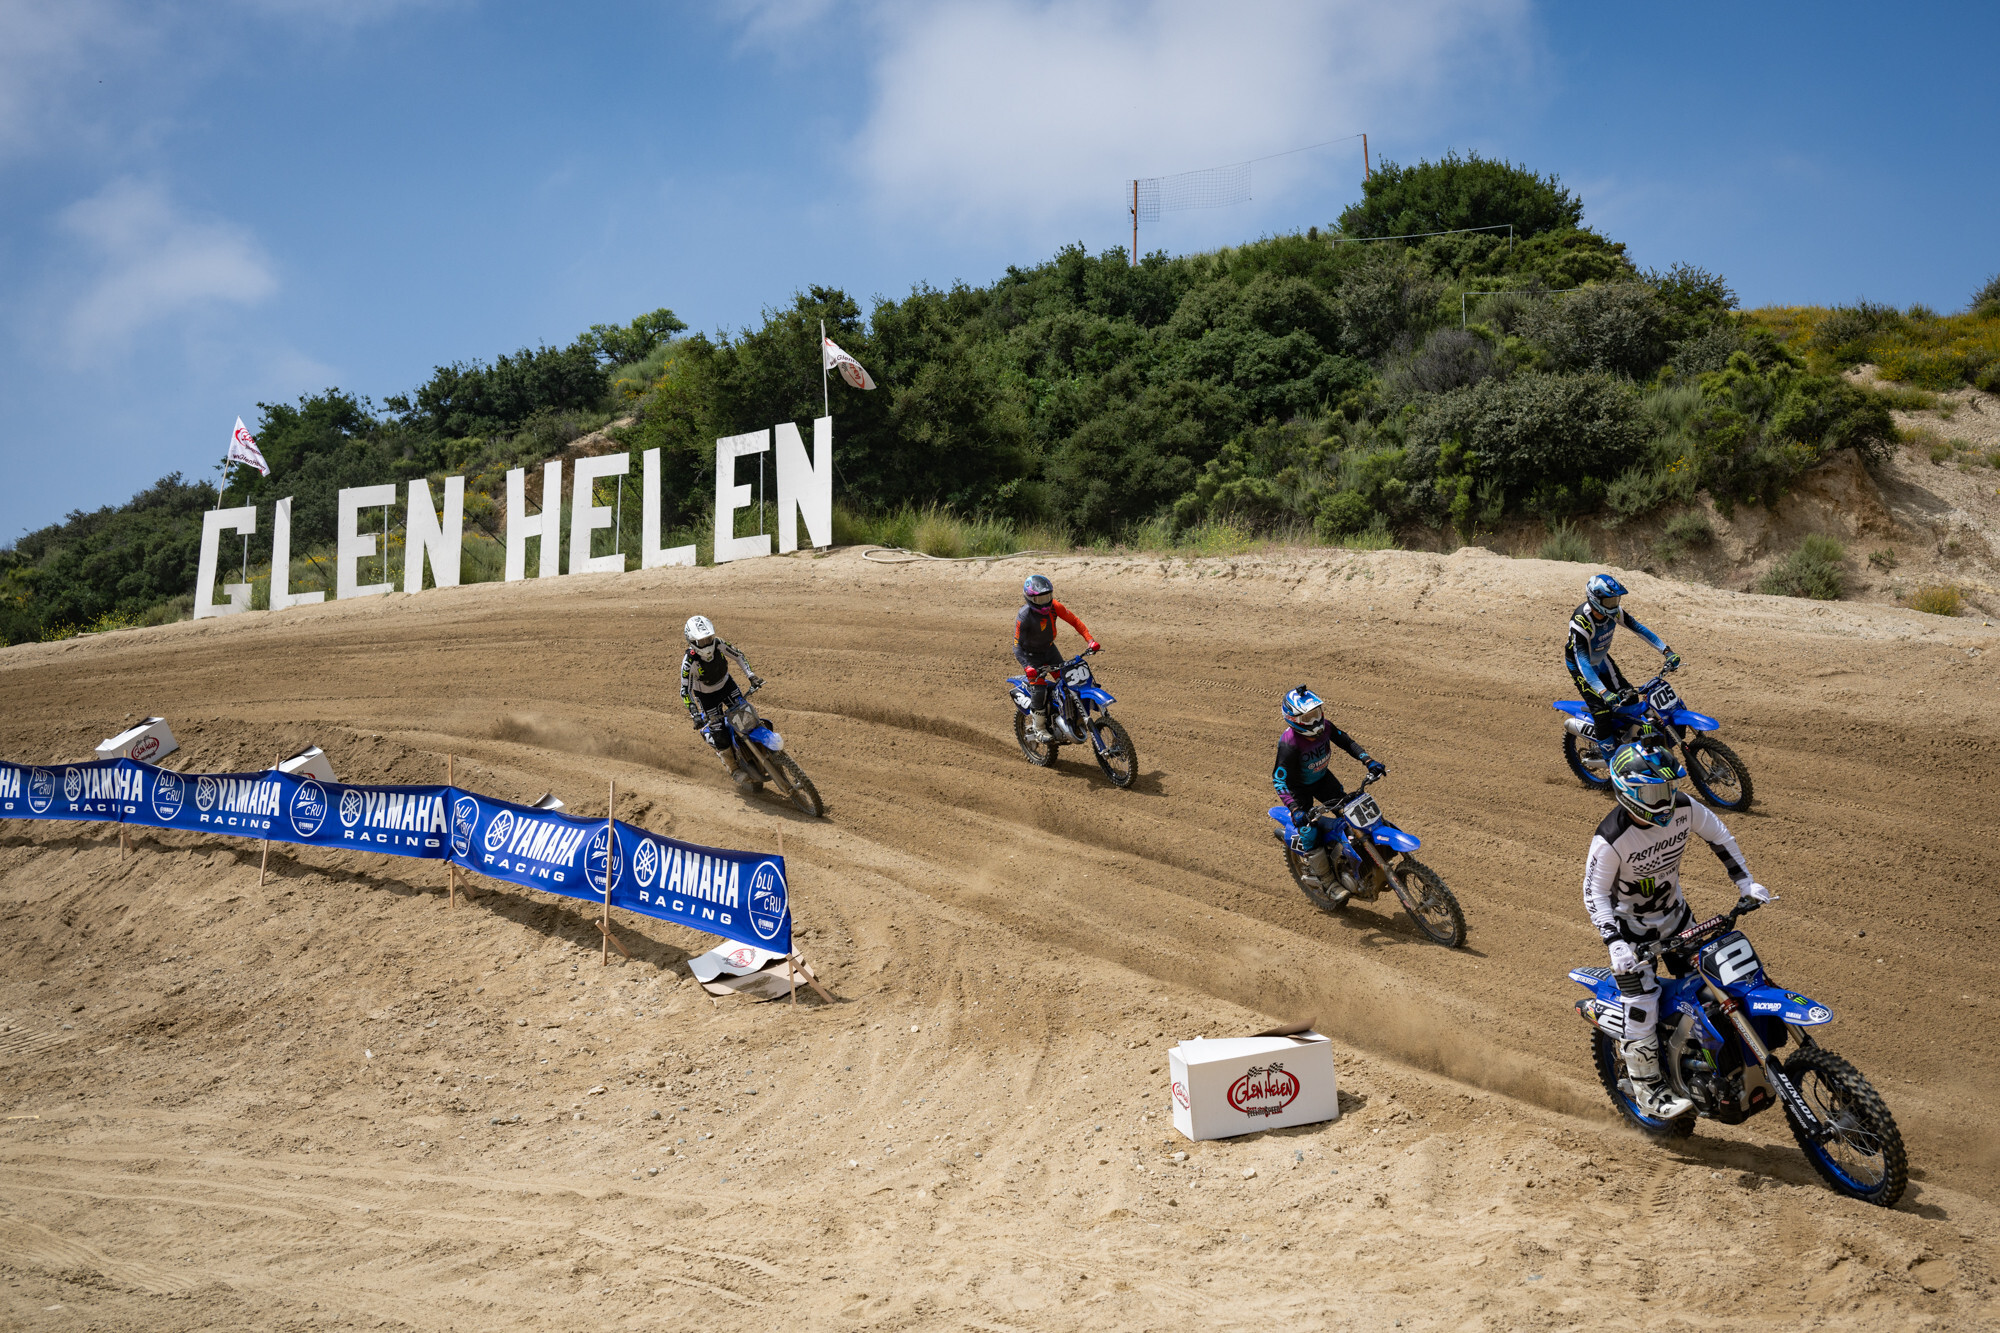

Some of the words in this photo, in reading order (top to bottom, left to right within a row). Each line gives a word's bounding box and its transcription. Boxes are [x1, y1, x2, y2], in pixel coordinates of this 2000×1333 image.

[194, 475, 465, 620] GLEN
[505, 416, 833, 581] HELEN
[1065, 665, 1090, 687] 30
[1014, 692, 1031, 709] 30
[1652, 686, 1677, 709] 105
[81, 768, 143, 802] YAMAHA
[216, 778, 281, 817] YAMAHA
[200, 814, 271, 829] RACING
[363, 791, 448, 833] YAMAHA
[1349, 796, 1381, 827] 15
[344, 829, 441, 848] RACING
[507, 816, 587, 868] YAMAHA
[1626, 827, 1690, 864] FASTHOUSE
[484, 854, 565, 882] RACING
[659, 845, 739, 909] YAMAHA
[639, 890, 732, 925] RACING
[1681, 917, 1722, 939] RENTHAL
[1714, 939, 1759, 986] 2
[1235, 1076, 1263, 1104] GLEN
[1265, 1073, 1292, 1099] HELEN
[1778, 1072, 1818, 1123] DUNLOP
